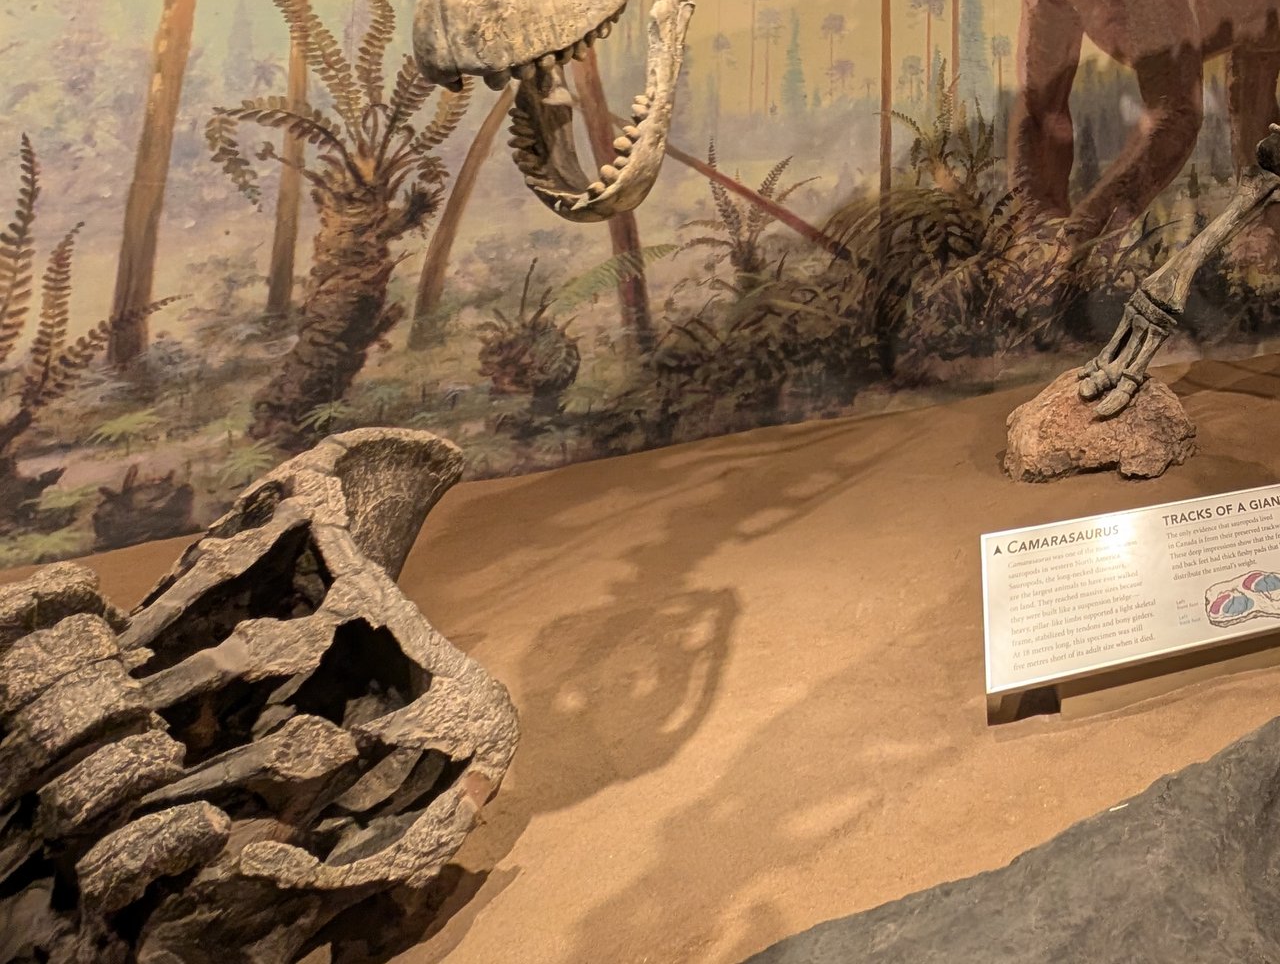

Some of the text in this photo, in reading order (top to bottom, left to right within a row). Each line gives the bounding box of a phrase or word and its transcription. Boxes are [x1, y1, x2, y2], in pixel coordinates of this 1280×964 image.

[1162, 508, 1213, 526] TRACKS
[1215, 504, 1234, 516] OF
[1236, 502, 1247, 513] A
[1175, 539, 1197, 547] Canada
[1234, 526, 1260, 538] preserved
[1179, 529, 1192, 537] only
[1193, 526, 1218, 534] evidence
[1231, 517, 1259, 527] sauropods
[1007, 525, 1119, 554] CAMARASAURUS
[1202, 543, 1236, 553] impressions
[1183, 559, 1197, 567] back
[1209, 554, 1221, 562] had
[1222, 551, 1236, 559] thick
[1254, 546, 1267, 555] pads
[1008, 568, 1040, 579] sauropods
[1050, 563, 1073, 571] western
[1074, 557, 1093, 566] North
[1172, 571, 1202, 580] distribute
[1032, 587, 1053, 596] largest
[1055, 582, 1078, 592] animals
[1055, 592, 1078, 603] reached
[1080, 589, 1103, 598] massive
[1042, 608, 1057, 616] built
[1058, 605, 1071, 613] like
[1078, 598, 1111, 609] suspension
[1064, 614, 1081, 623] limbs
[1083, 607, 1113, 620] supported
[1119, 604, 1133, 613] light
[1134, 598, 1156, 609] skeletal
[1035, 628, 1065, 641] stabilized
[1066, 627, 1074, 636] by
[1075, 623, 1101, 633] tendons
[1102, 618, 1114, 627] and
[1013, 650, 1020, 658] At
[1031, 645, 1054, 654] metres
[1072, 636, 1085, 645] this
[1087, 631, 1117, 643] specimen
[1131, 623, 1143, 632] still
[1026, 658, 1048, 667] metres
[1050, 653, 1067, 662] short
[1068, 650, 1076, 658] of
[1085, 645, 1101, 654] adult
[1116, 639, 1133, 647] when
